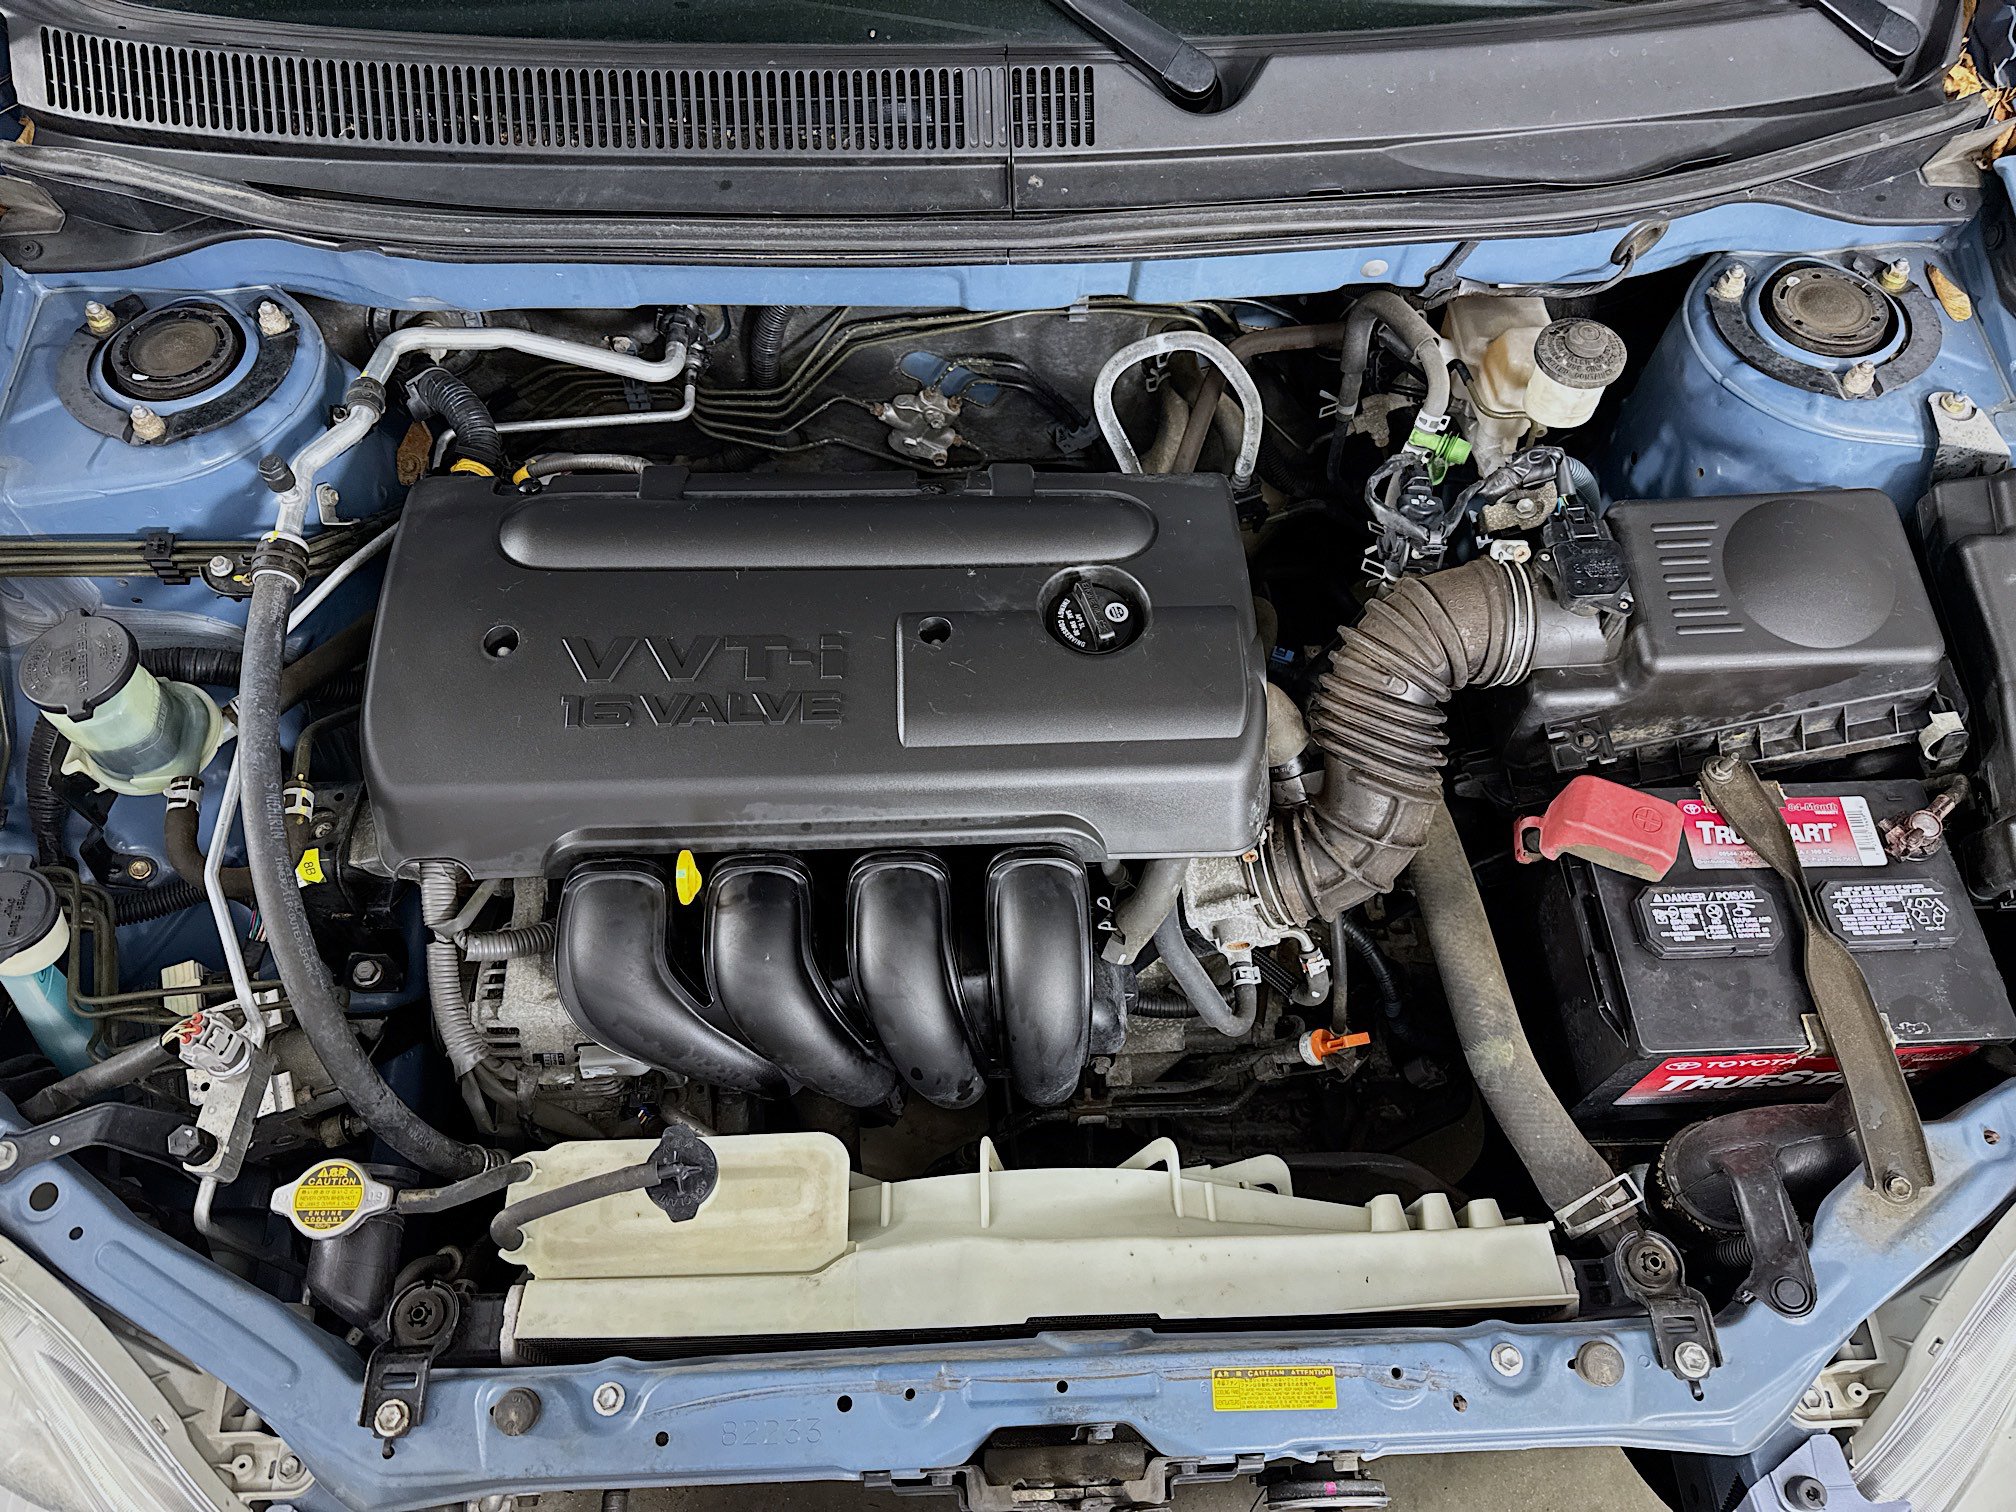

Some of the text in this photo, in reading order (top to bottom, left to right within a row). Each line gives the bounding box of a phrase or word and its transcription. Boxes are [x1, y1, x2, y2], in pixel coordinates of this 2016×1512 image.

[1057, 619, 1086, 648] CONSERVING
[561, 634, 844, 682] VVT-i
[560, 690, 843, 728] 16 VALVE
[1662, 892, 1707, 903] DANGER
[1715, 890, 1756, 901] POISON
[1706, 1058, 1799, 1070] TOYOTA
[307, 1177, 357, 1186] CAUTION
[1247, 1370, 1285, 1378] CAUTION
[1291, 1368, 1331, 1376] ATTENTION
[721, 1418, 822, 1446] 82233
